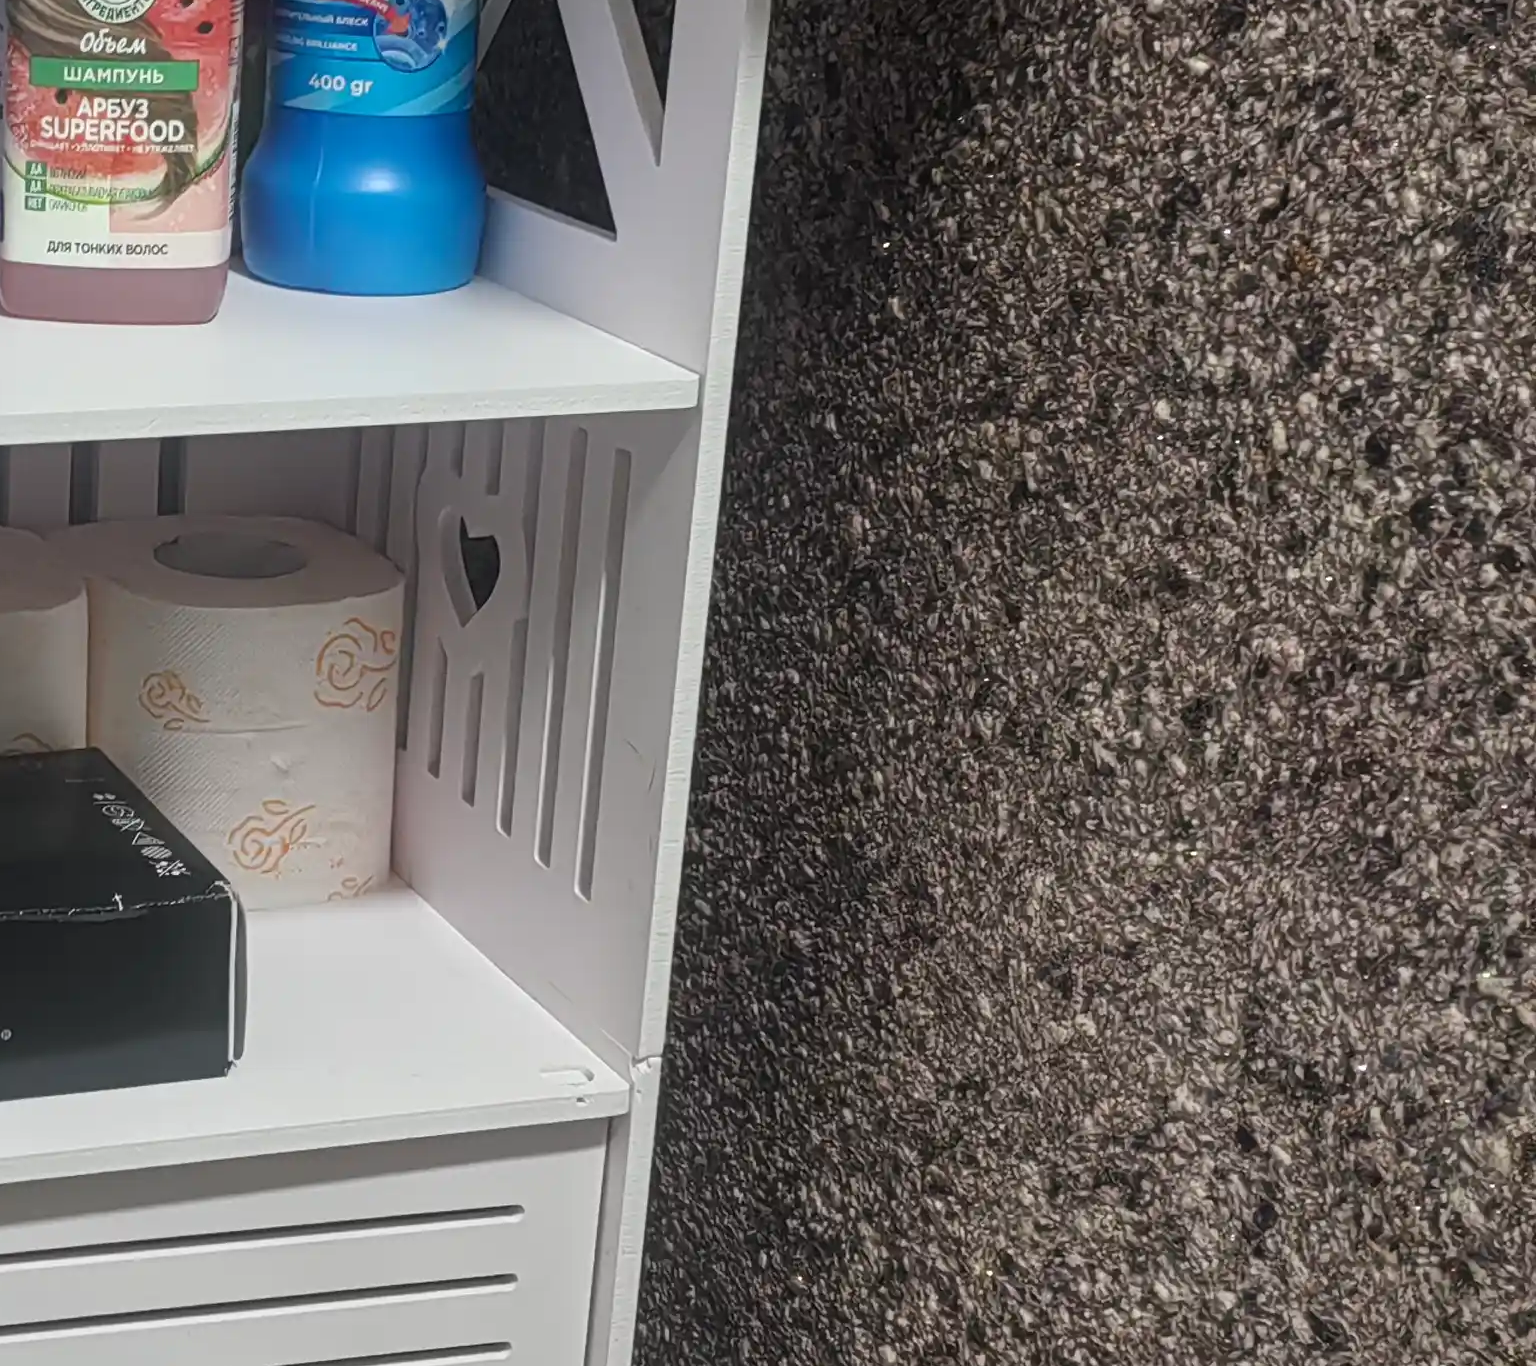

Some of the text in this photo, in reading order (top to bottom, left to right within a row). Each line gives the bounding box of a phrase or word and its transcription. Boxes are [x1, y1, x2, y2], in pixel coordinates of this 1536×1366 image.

[79, 31, 148, 57] Объем
[63, 65, 165, 86] ШАМПУНЬ
[308, 72, 374, 99] 400 gr
[77, 96, 150, 118] АРБУЗ
[40, 117, 185, 144] SUPERFOOD
[30, 163, 43, 176] ДА
[29, 181, 42, 193] ДА
[27, 198, 44, 210] НЕТ
[46, 241, 169, 257] ДЛЯ ТОНКИХ ВОЛОС
